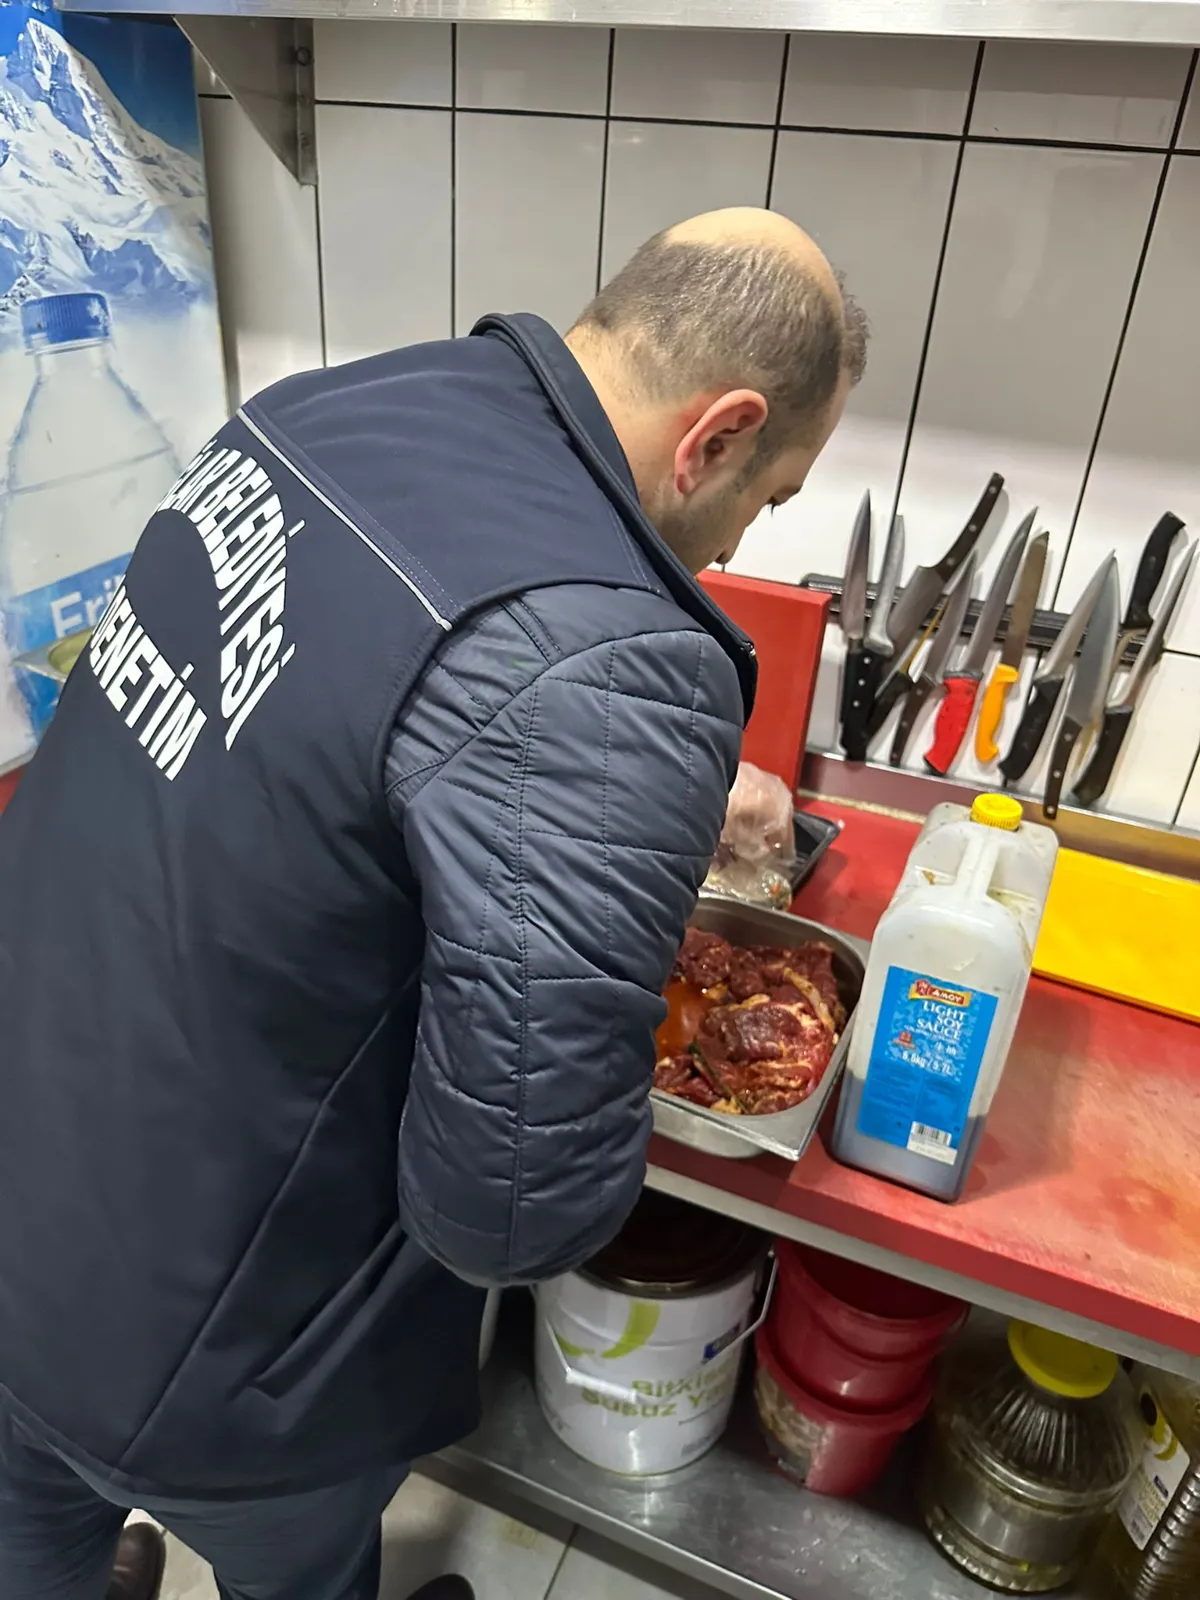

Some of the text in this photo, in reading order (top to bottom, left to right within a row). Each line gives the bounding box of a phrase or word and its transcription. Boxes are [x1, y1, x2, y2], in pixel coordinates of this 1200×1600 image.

[188, 456, 305, 751] BELEDİYESİ
[89, 584, 207, 782] DENETİM
[923, 1000, 967, 1020] LIGHT
[917, 1018, 961, 1040] SAUCE
[937, 1014, 964, 1030] SOY
